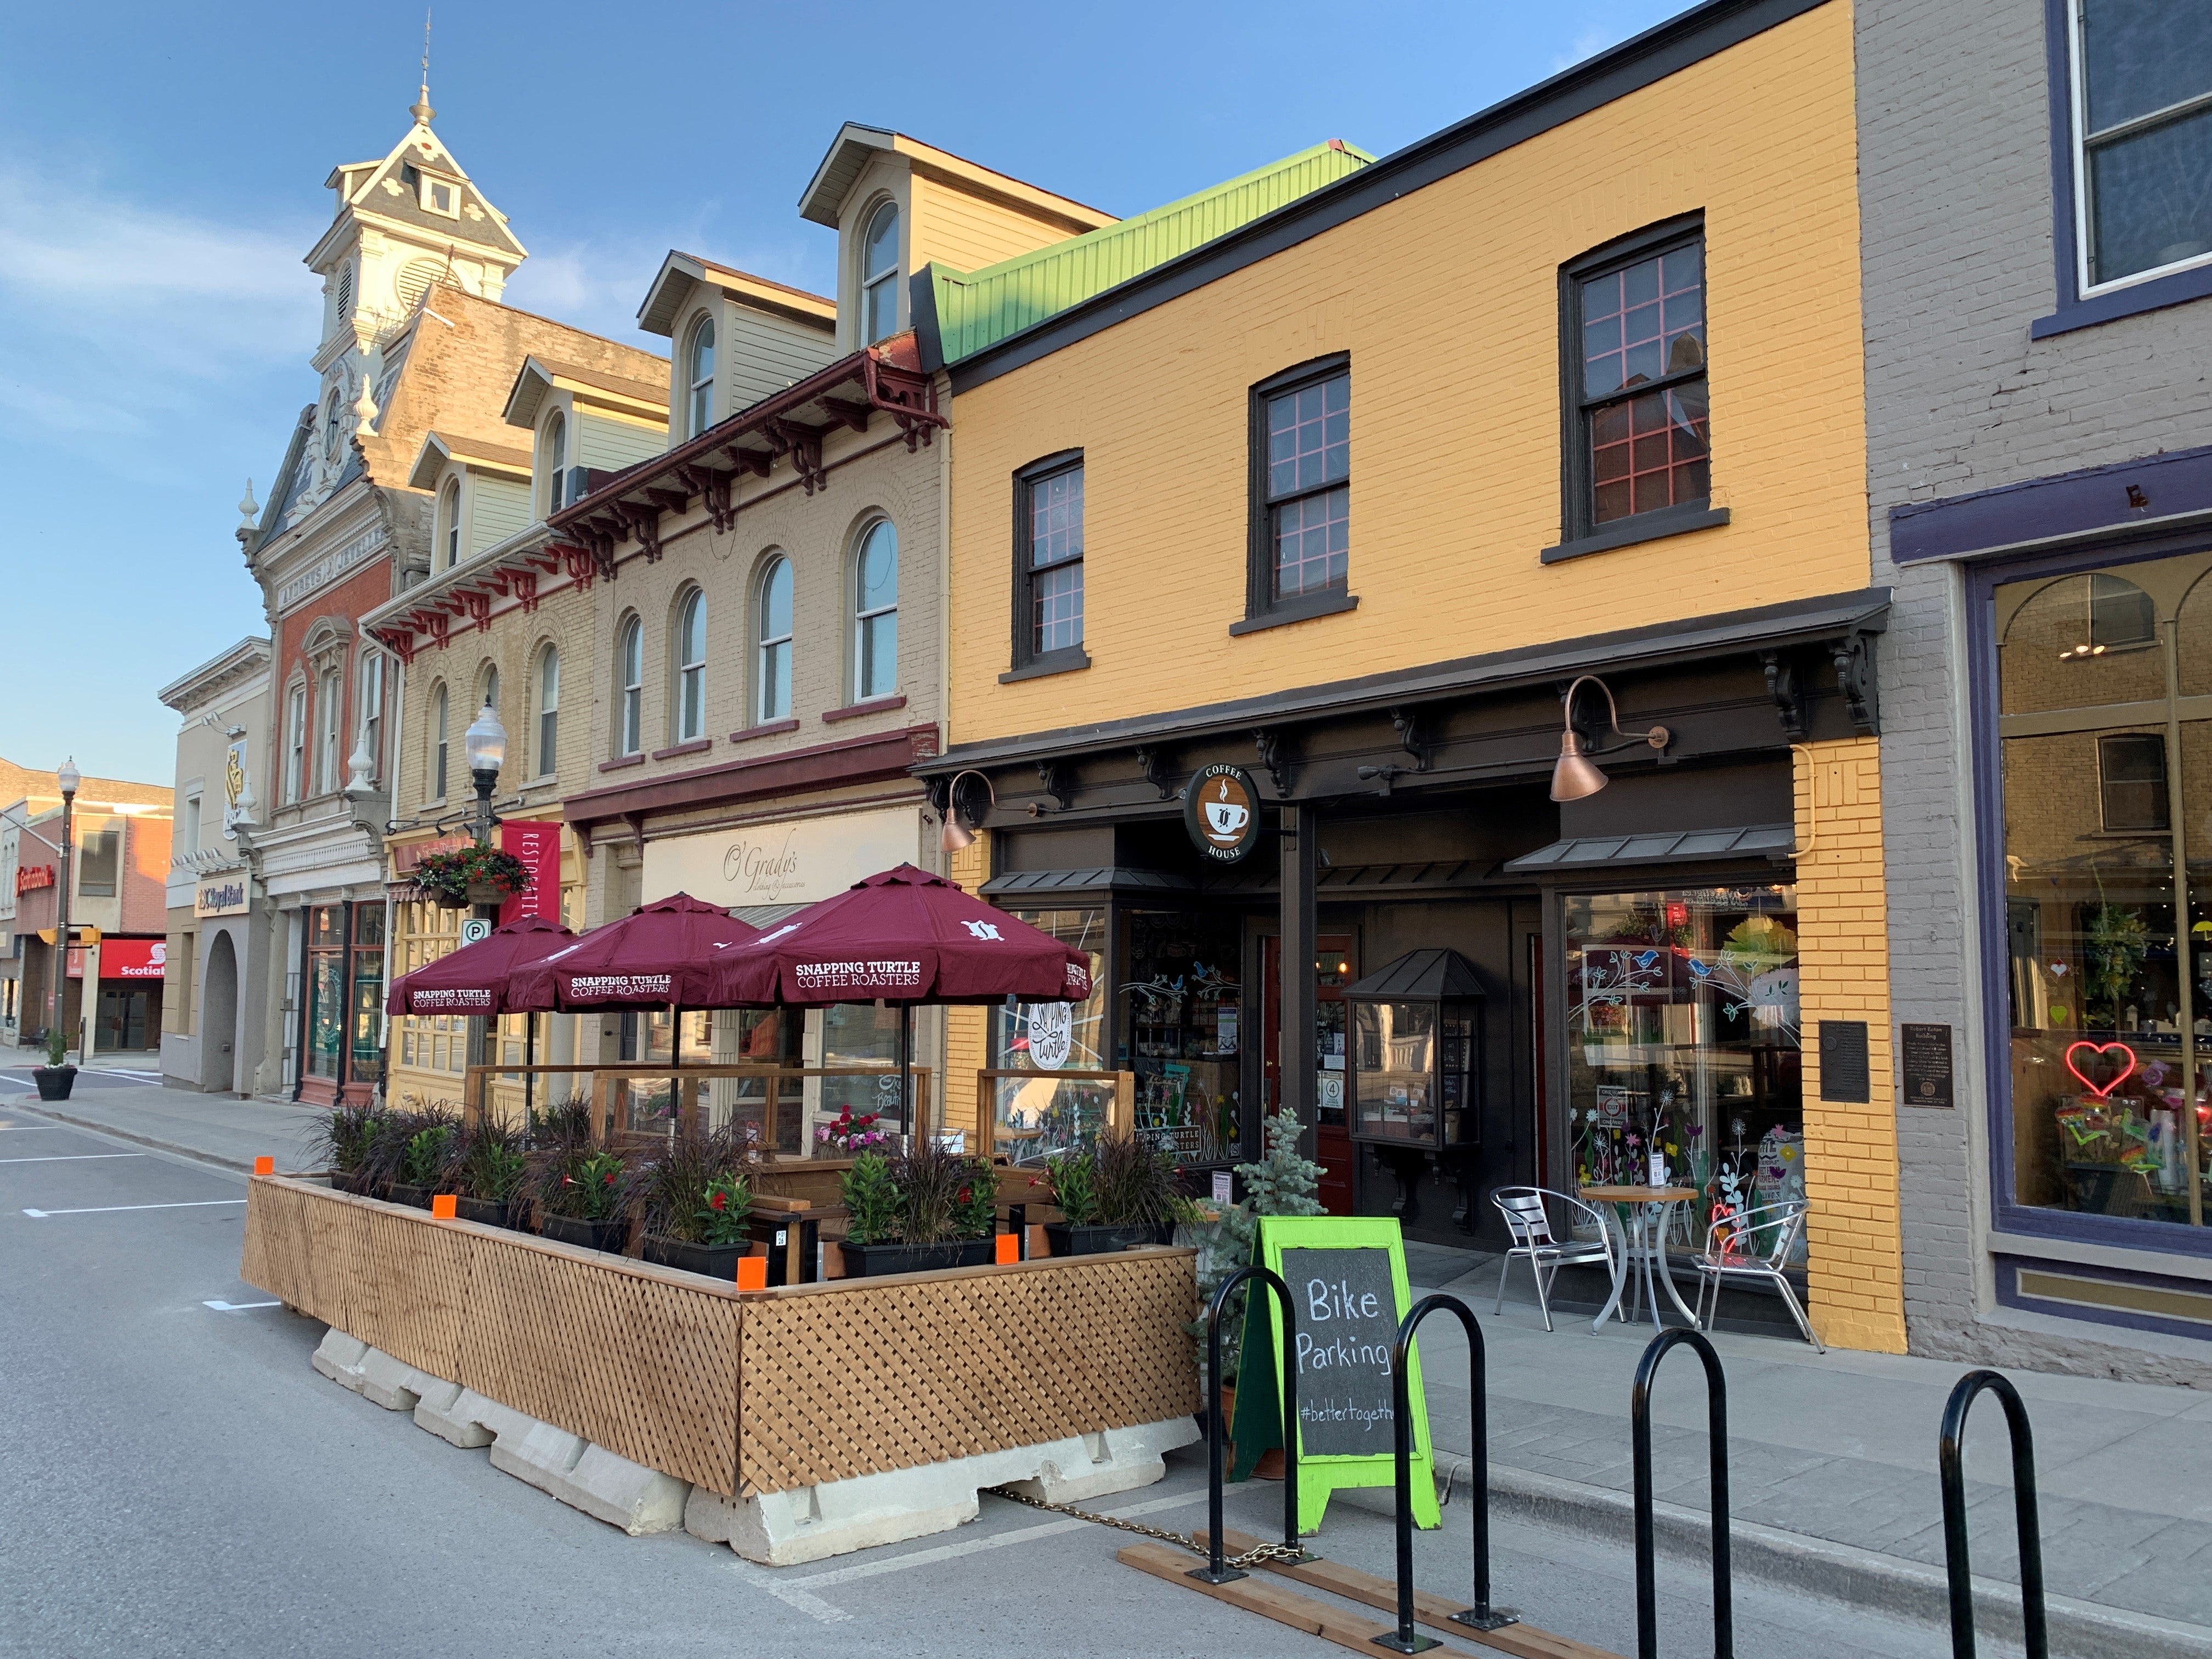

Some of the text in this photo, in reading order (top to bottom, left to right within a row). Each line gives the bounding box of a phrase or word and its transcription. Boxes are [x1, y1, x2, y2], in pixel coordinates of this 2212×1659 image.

[1206, 764, 1242, 780] COFFEE
[1208, 845, 1241, 859] HOUSE
[724, 827, 797, 901] O'Grady's
[210, 884, 227, 913] Royal
[227, 882, 244, 907] Bank
[471, 927, 480, 938] P
[796, 961, 920, 976] SNAPPING TURTLE
[571, 974, 672, 988] SNAPPING TURTLE
[798, 974, 919, 988] COFFEE ROASTERS
[414, 989, 490, 999] SNAPPING TURTLE
[571, 984, 670, 997] COFFEE ROASTERS
[414, 997, 490, 1008] COFFEE ROASTERS
[1329, 1083, 1335, 1095] 4
[1170, 1130, 1199, 1139] TURTLE
[1307, 1278, 1378, 1321] Bike
[1295, 1333, 1391, 1375] Parking
